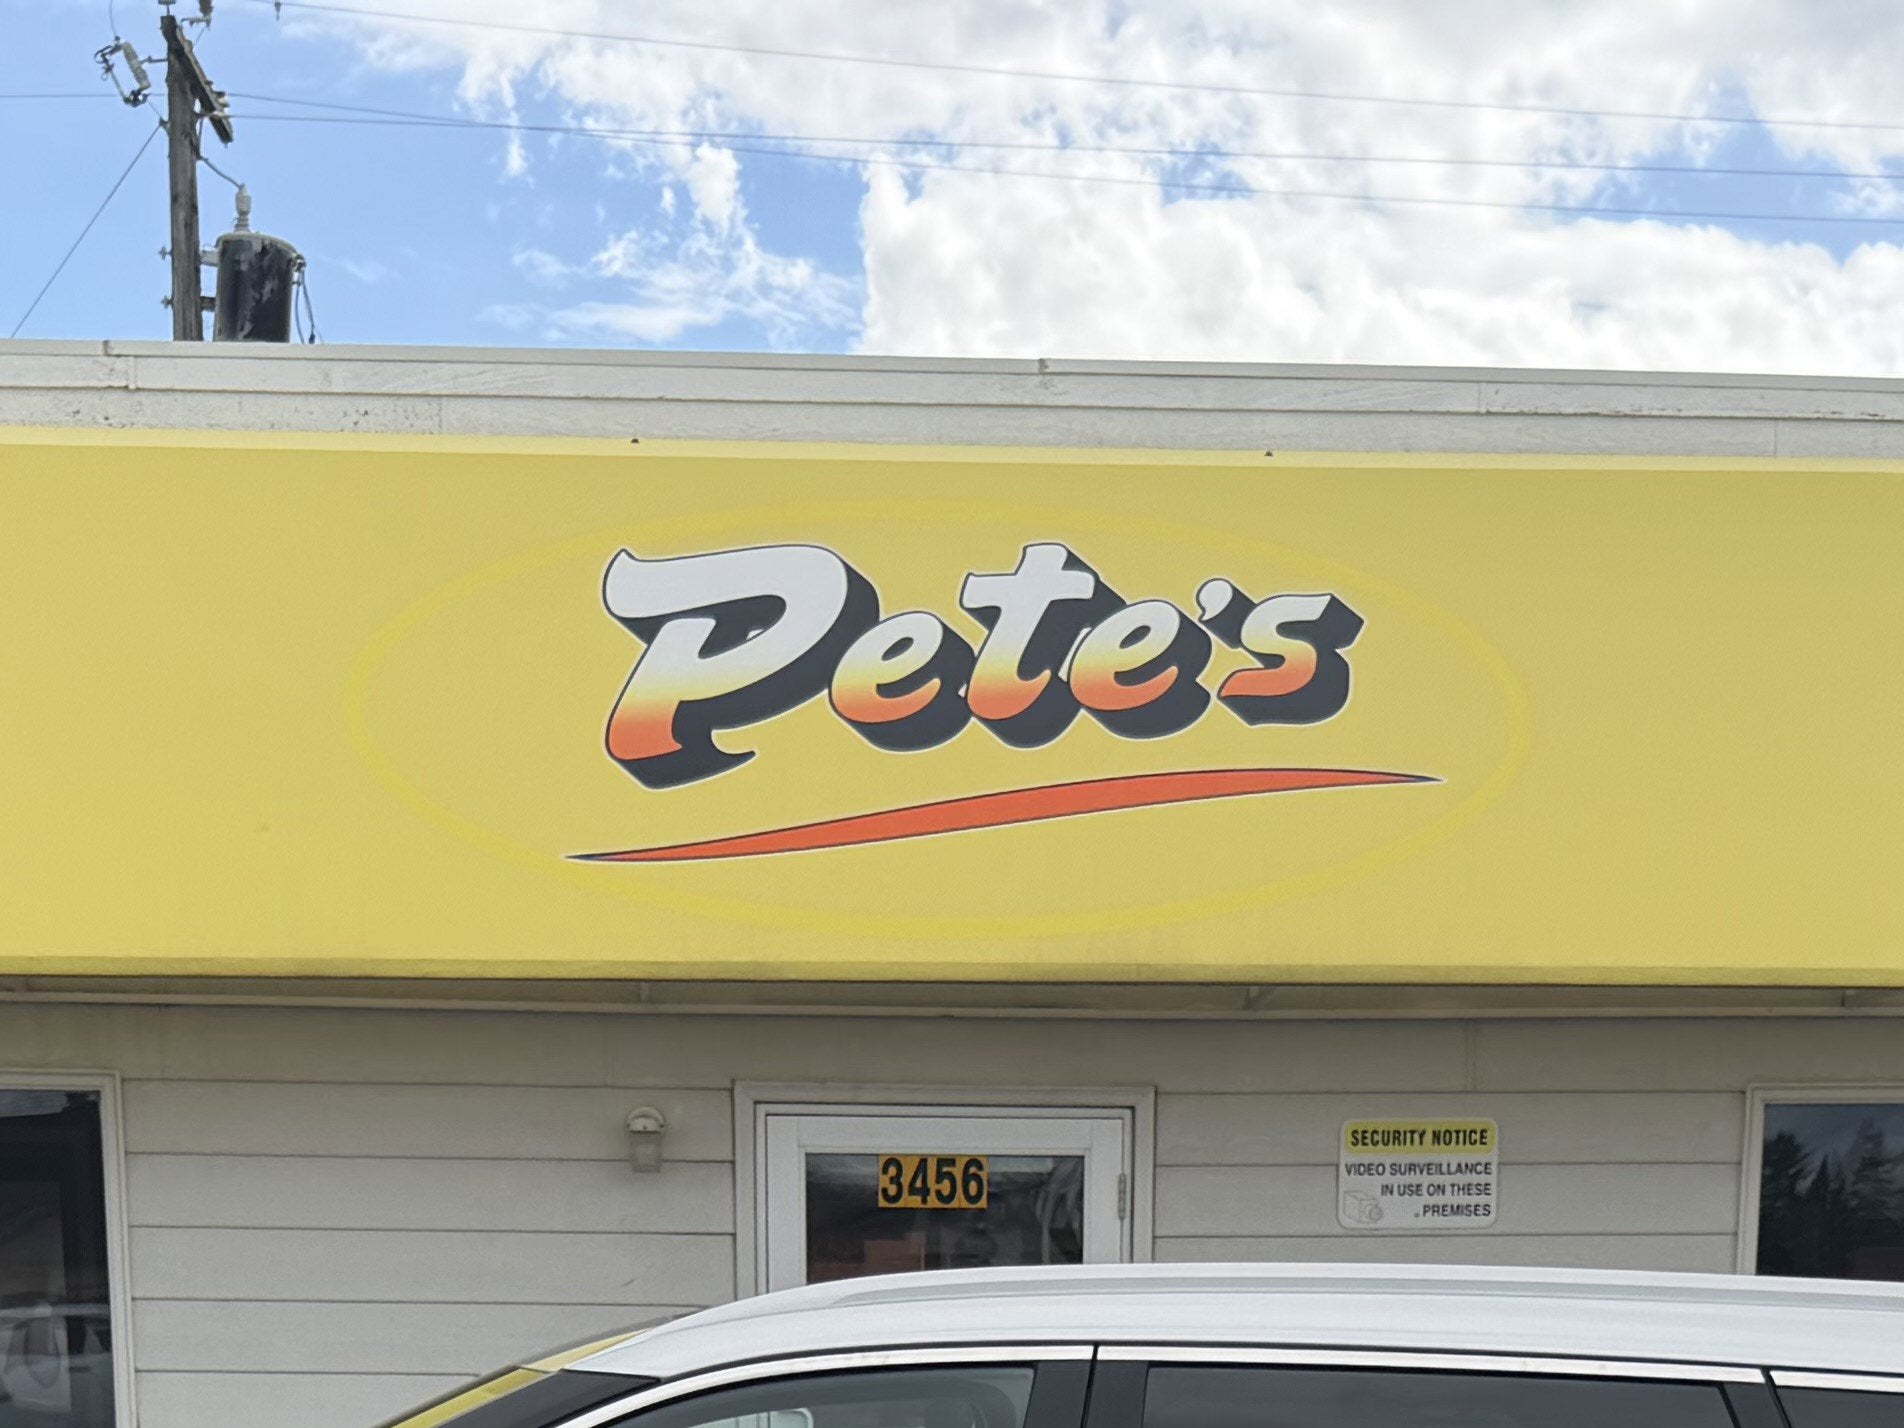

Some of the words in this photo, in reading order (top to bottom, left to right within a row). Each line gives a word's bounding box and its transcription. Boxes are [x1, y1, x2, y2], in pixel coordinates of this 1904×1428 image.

[602, 542, 1364, 790] Pete's
[1351, 1129, 1426, 1146] SECURITY
[1431, 1128, 1488, 1146] NOTICE
[1345, 1163, 1386, 1177] VIDEO
[1389, 1162, 1492, 1176] SURVEILLANCE
[881, 1157, 986, 1205] 3456
[1381, 1184, 1394, 1196] IN
[1397, 1184, 1423, 1196] USE
[1427, 1183, 1446, 1196] ON
[1450, 1183, 1492, 1196] THESE
[1422, 1204, 1491, 1217] PREMISES
